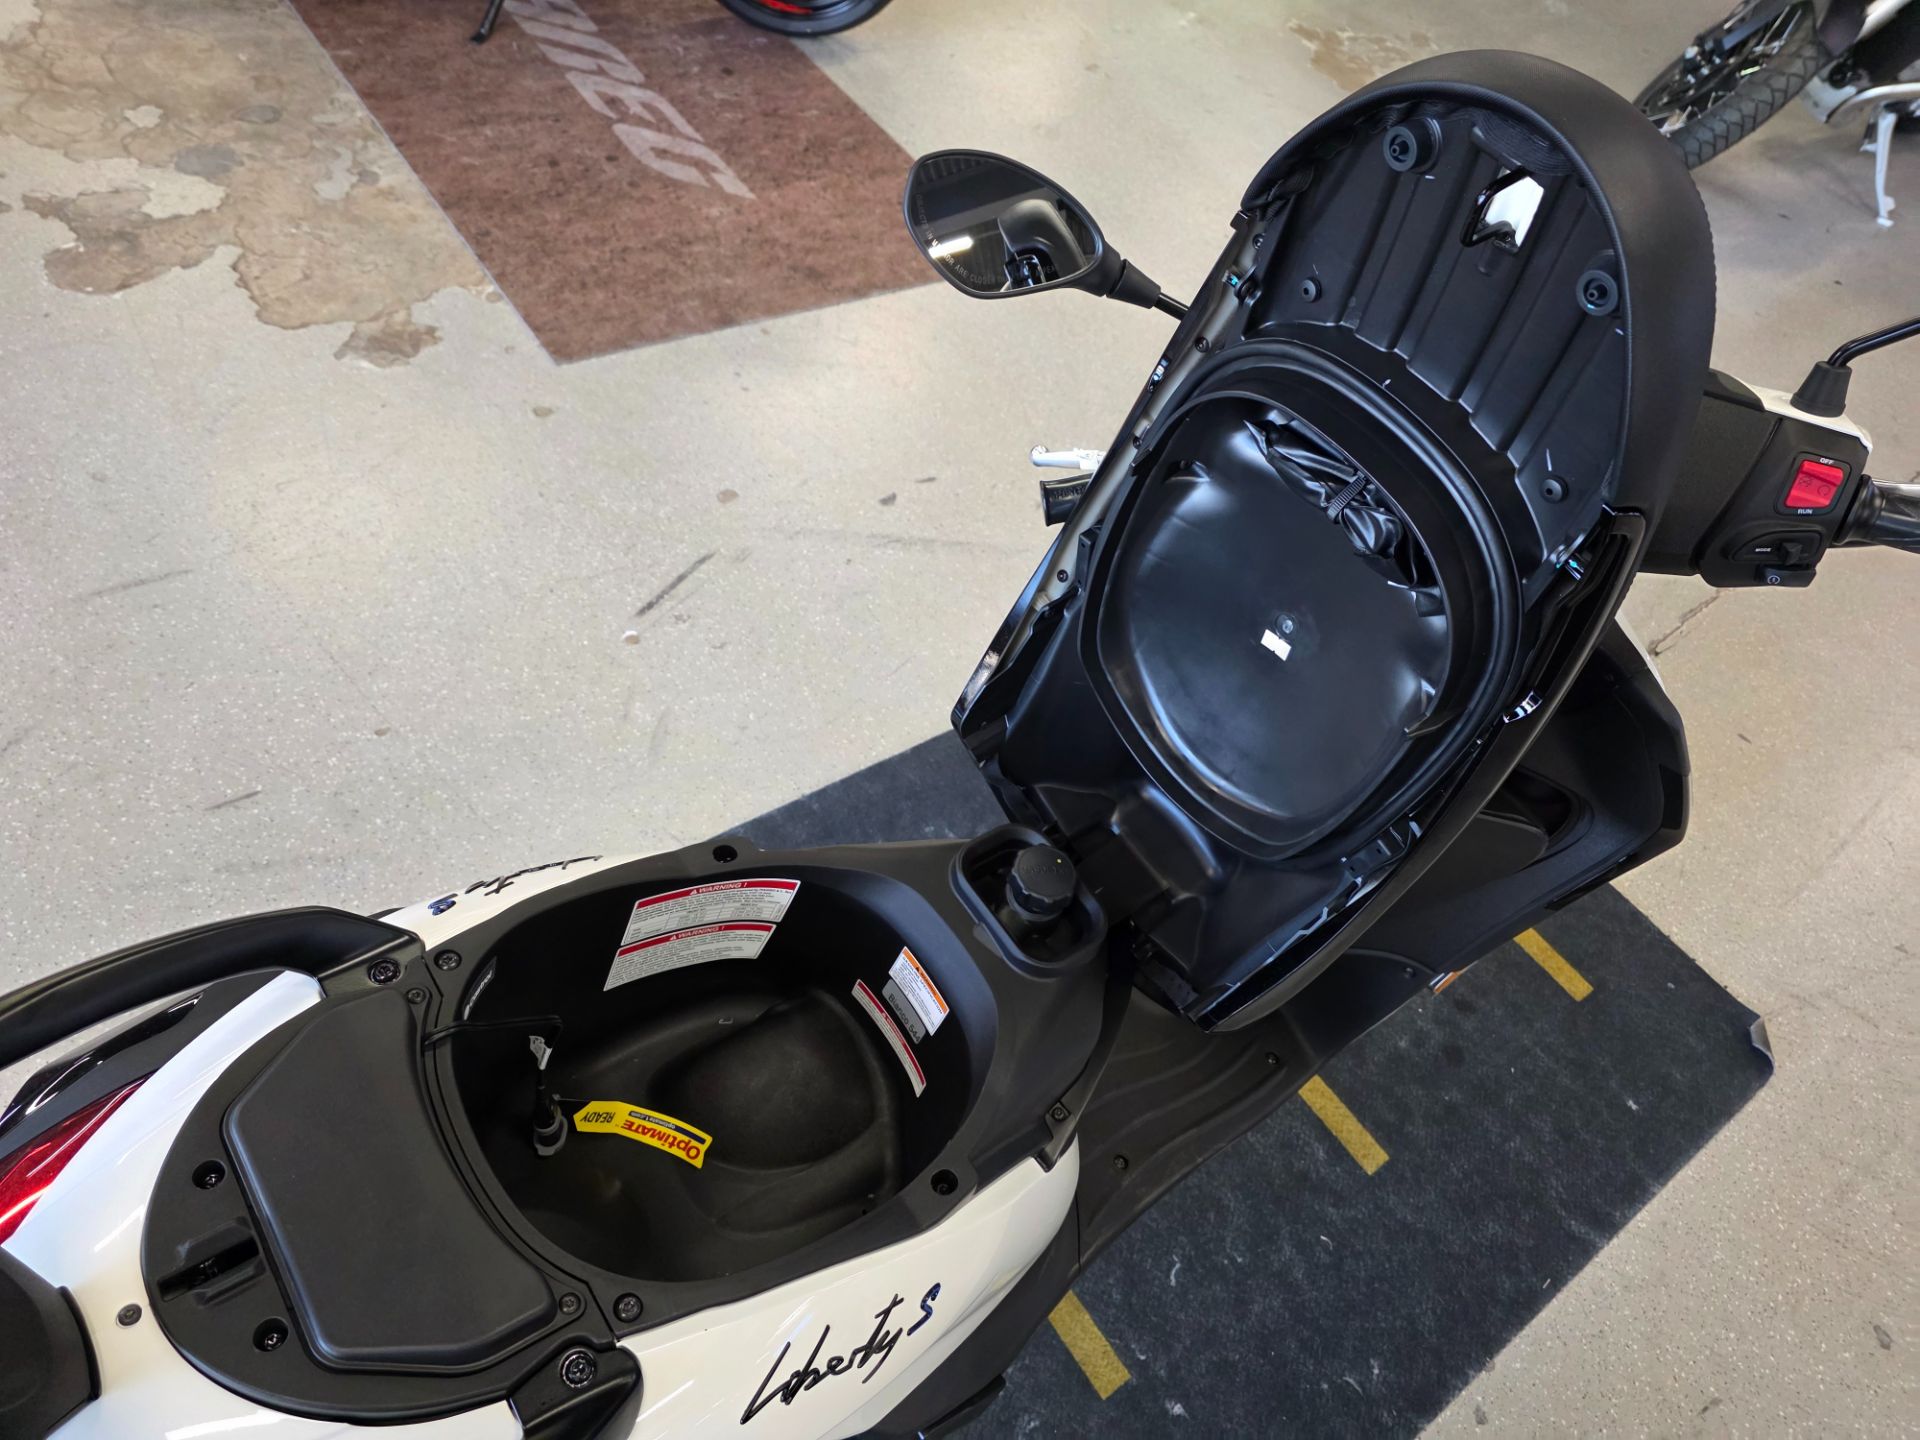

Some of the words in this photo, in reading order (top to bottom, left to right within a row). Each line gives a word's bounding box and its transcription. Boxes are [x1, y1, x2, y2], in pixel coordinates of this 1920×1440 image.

[1819, 457, 1835, 465] OFF
[699, 882, 742, 893] WARNING
[678, 926, 720, 939] WARNING
[908, 1023, 921, 1043] 544
[580, 1111, 616, 1124] READY
[621, 1119, 701, 1161] OptiMATE
[741, 1293, 905, 1425] Liberty
[906, 1282, 941, 1336] S
